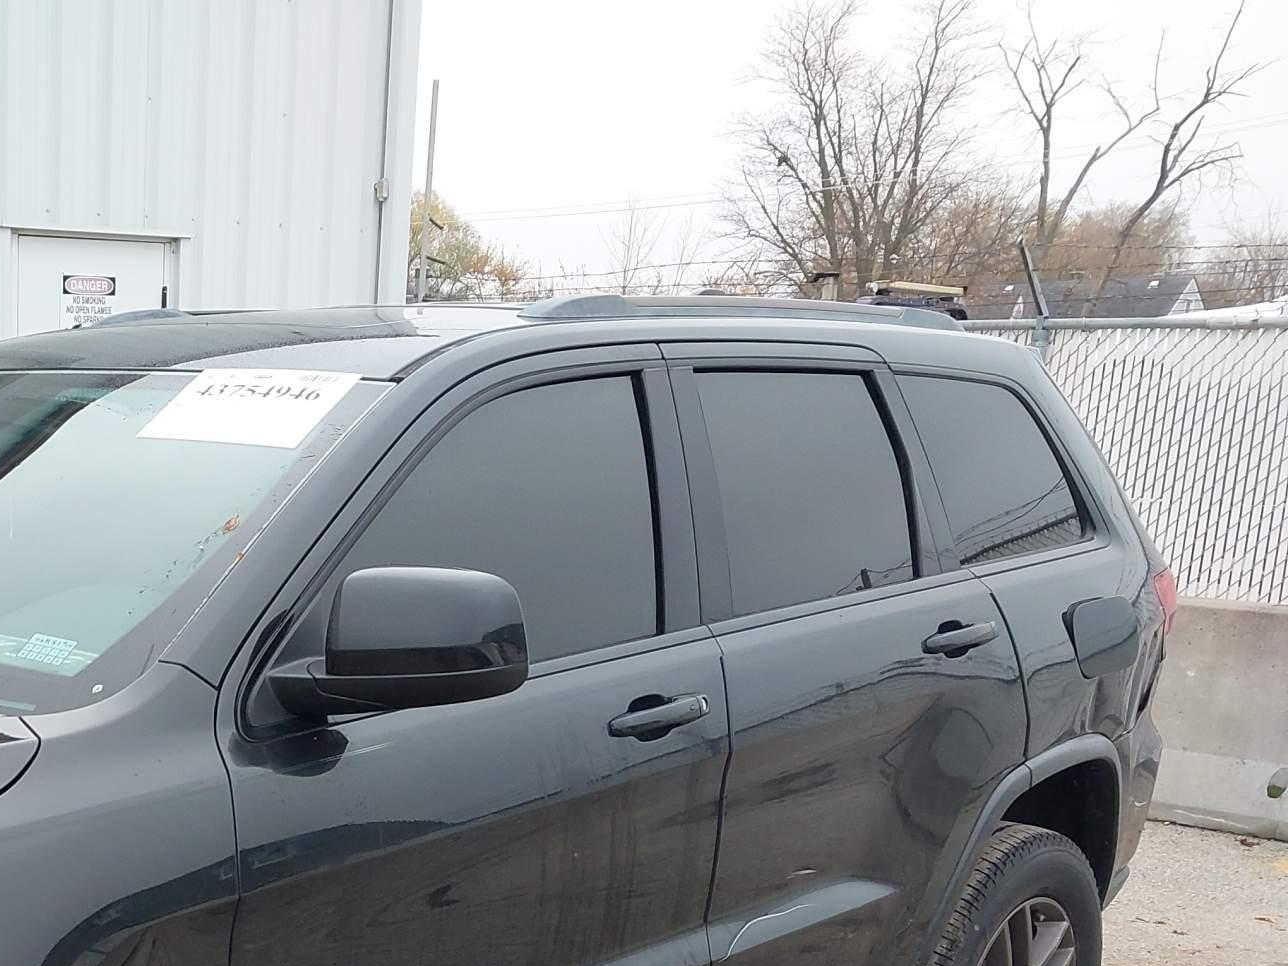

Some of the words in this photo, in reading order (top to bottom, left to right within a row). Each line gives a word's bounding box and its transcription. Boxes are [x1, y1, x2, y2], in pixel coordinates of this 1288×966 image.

[70, 279, 108, 291] DANGER
[72, 296, 81, 304] NO
[81, 296, 106, 305] SMOKING
[66, 305, 74, 314] NO
[75, 306, 90, 314] OPEN
[90, 306, 112, 315] FLAMES
[73, 315, 82, 323] NO
[196, 384, 321, 401] 43754946
